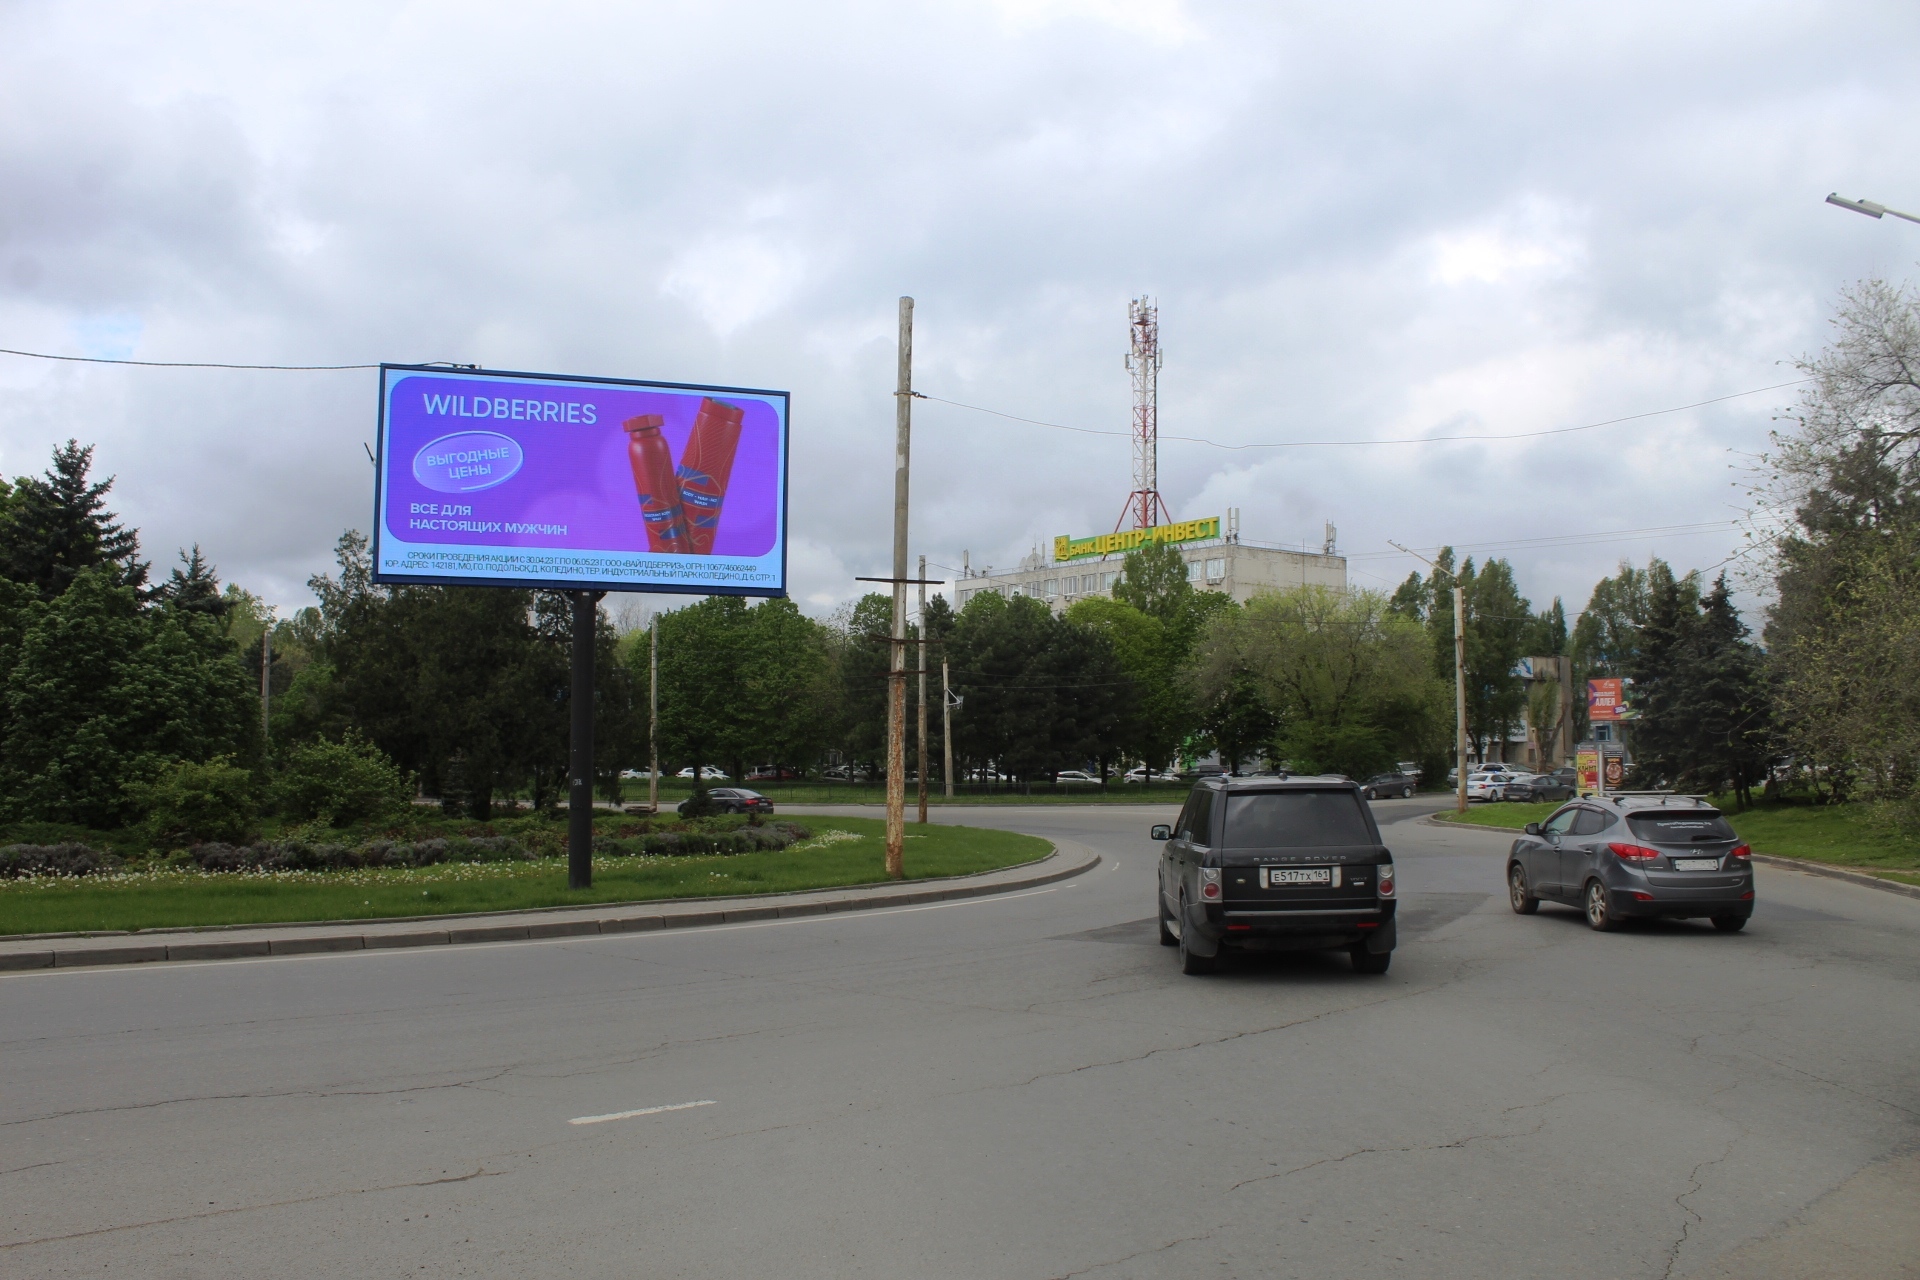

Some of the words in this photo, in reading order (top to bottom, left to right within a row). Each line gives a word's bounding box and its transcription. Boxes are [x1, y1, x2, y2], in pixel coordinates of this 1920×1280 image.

[423, 393, 598, 425] WILDBERRIES
[426, 447, 510, 467] ВЫГОДНЫЕ
[448, 463, 492, 480] ЦЕНЫ
[410, 503, 439, 515] ВСЕ
[441, 504, 472, 517] ДЛЯ
[409, 518, 502, 534] НАСТОЯЩИХ
[504, 522, 568, 536] МУЖЧИН
[1069, 541, 1096, 556] БАНК
[1095, 517, 1218, 555] ЦЕНТР-ИНВЕСТ
[385, 559, 399, 568] ЮР.
[401, 560, 429, 570] АДРЕС:
[432, 561, 457, 571] 142181,
[540, 565, 586, 576] КОЛЕДИНО,
[601, 567, 677, 578] ИНДУСТРИАЛЬНЫЙ
[677, 570, 698, 579] ПАРК
[407, 551, 436, 561] СРОКИ
[436, 552, 490, 563] ПРОВЕДЕНИЯ
[491, 555, 519, 564] АКЦИИ
[520, 555, 526, 564] С
[526, 556, 554, 565] 30.04.23
[560, 557, 572, 565] ПО
[606, 559, 622, 567] ООО
[685, 562, 706, 571] ОГРН
[1274, 871, 1312, 882] Е517ТХ
[1313, 870, 1328, 879] 161
